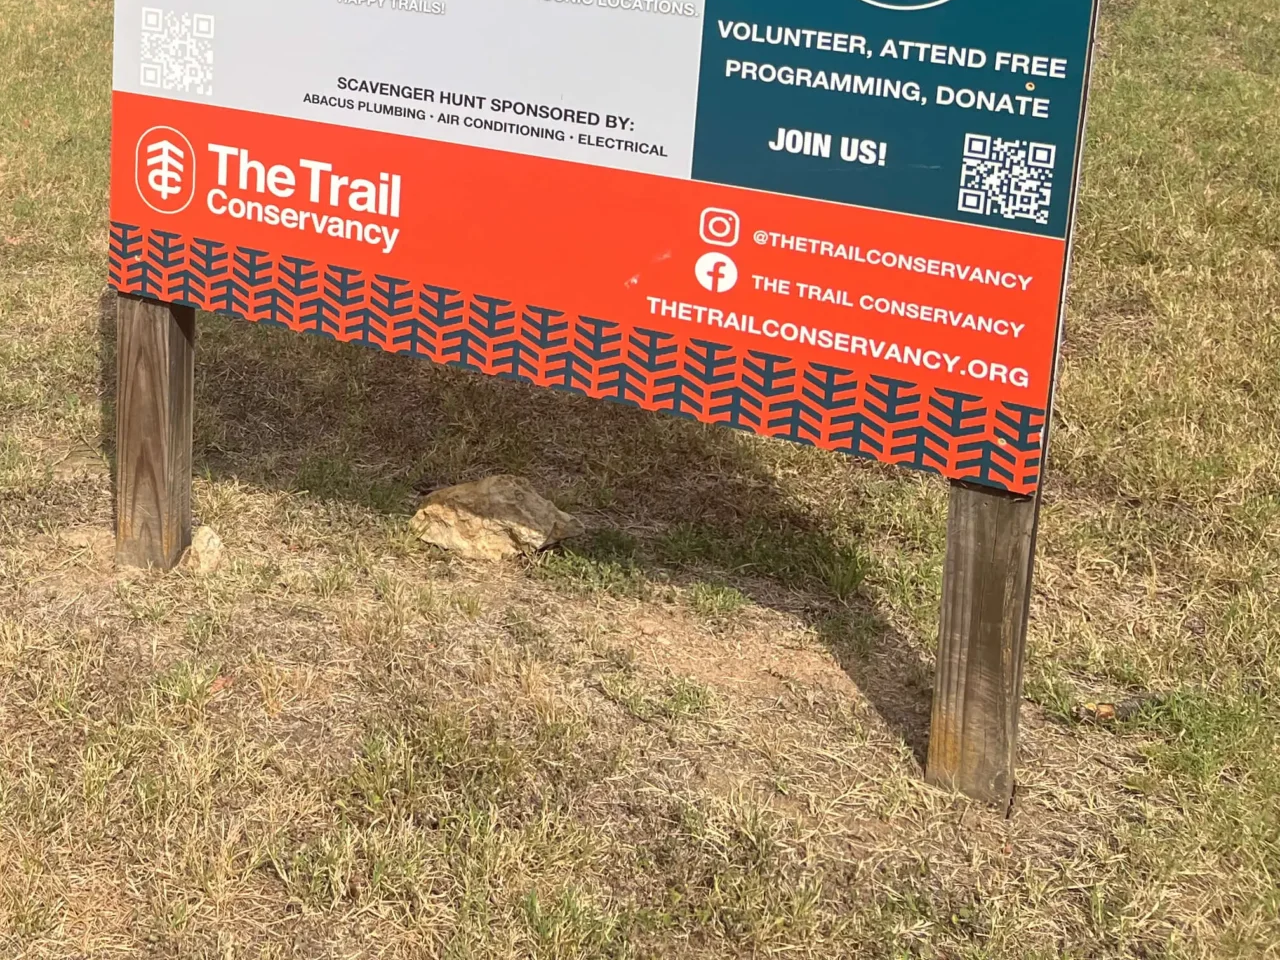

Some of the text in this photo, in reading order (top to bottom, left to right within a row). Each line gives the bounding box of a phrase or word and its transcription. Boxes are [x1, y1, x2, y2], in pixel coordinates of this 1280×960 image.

[718, 20, 1068, 78] VOLUNTEER, ATTEND FREE
[337, 76, 635, 132] SCAVENGER HUNT SPONSORED BY:
[725, 59, 1050, 118] PROGRAMMING, DONATE
[303, 93, 668, 157] ABACUS PLUMBING AIR CONDITIONING ELECTRICAL
[768, 128, 888, 166] JOIN US!
[208, 143, 401, 218] The Trail
[206, 188, 400, 254] Conservancy
[752, 230, 1033, 291] @THETRAILCONSERVANCY
[752, 275, 1025, 338] THE TRAIL CONSERVANCY
[646, 296, 1029, 388] THETRAILCONSERVANCY.ORG
